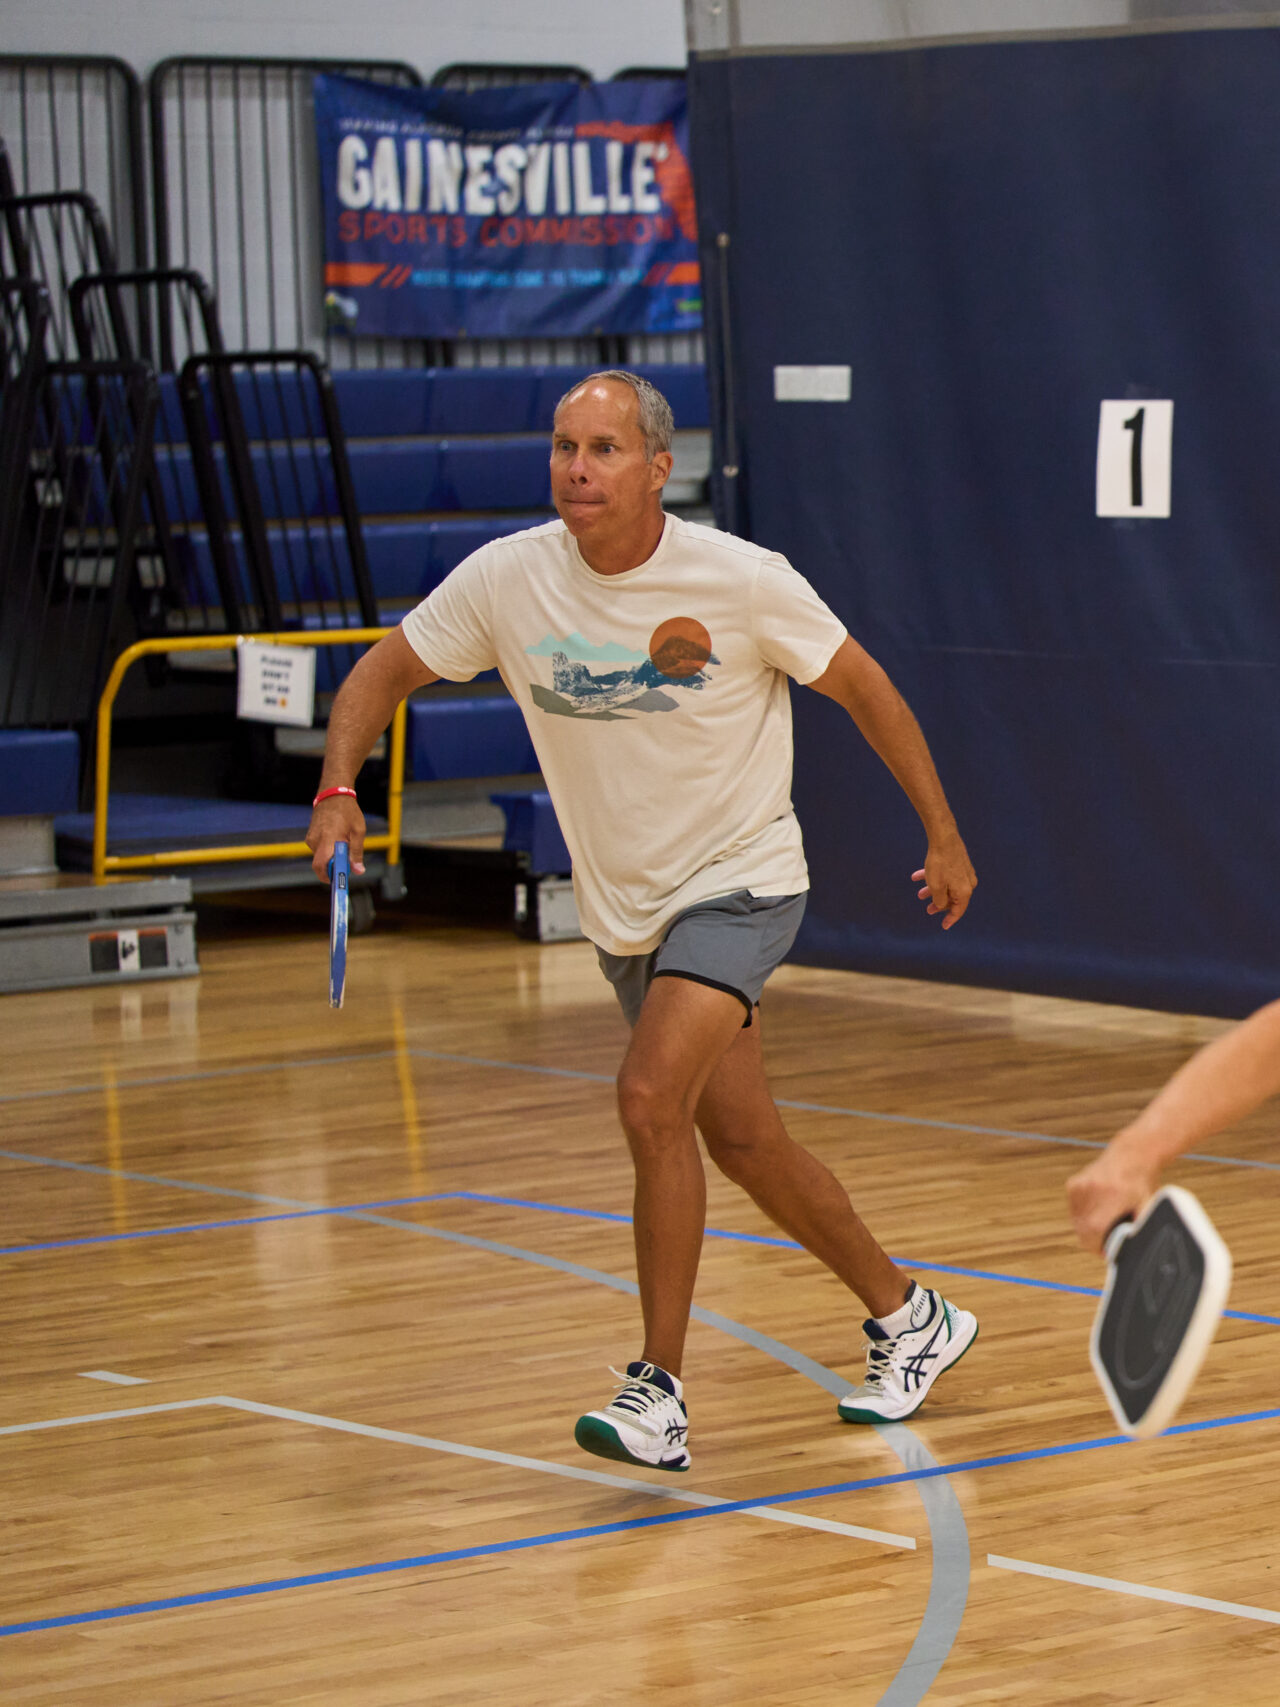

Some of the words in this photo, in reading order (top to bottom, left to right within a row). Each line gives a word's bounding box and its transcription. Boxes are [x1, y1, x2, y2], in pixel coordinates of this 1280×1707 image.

[338, 136, 662, 215] GAINESVILLE
[338, 211, 468, 247] SPORTS
[1123, 407, 1146, 506] 1
